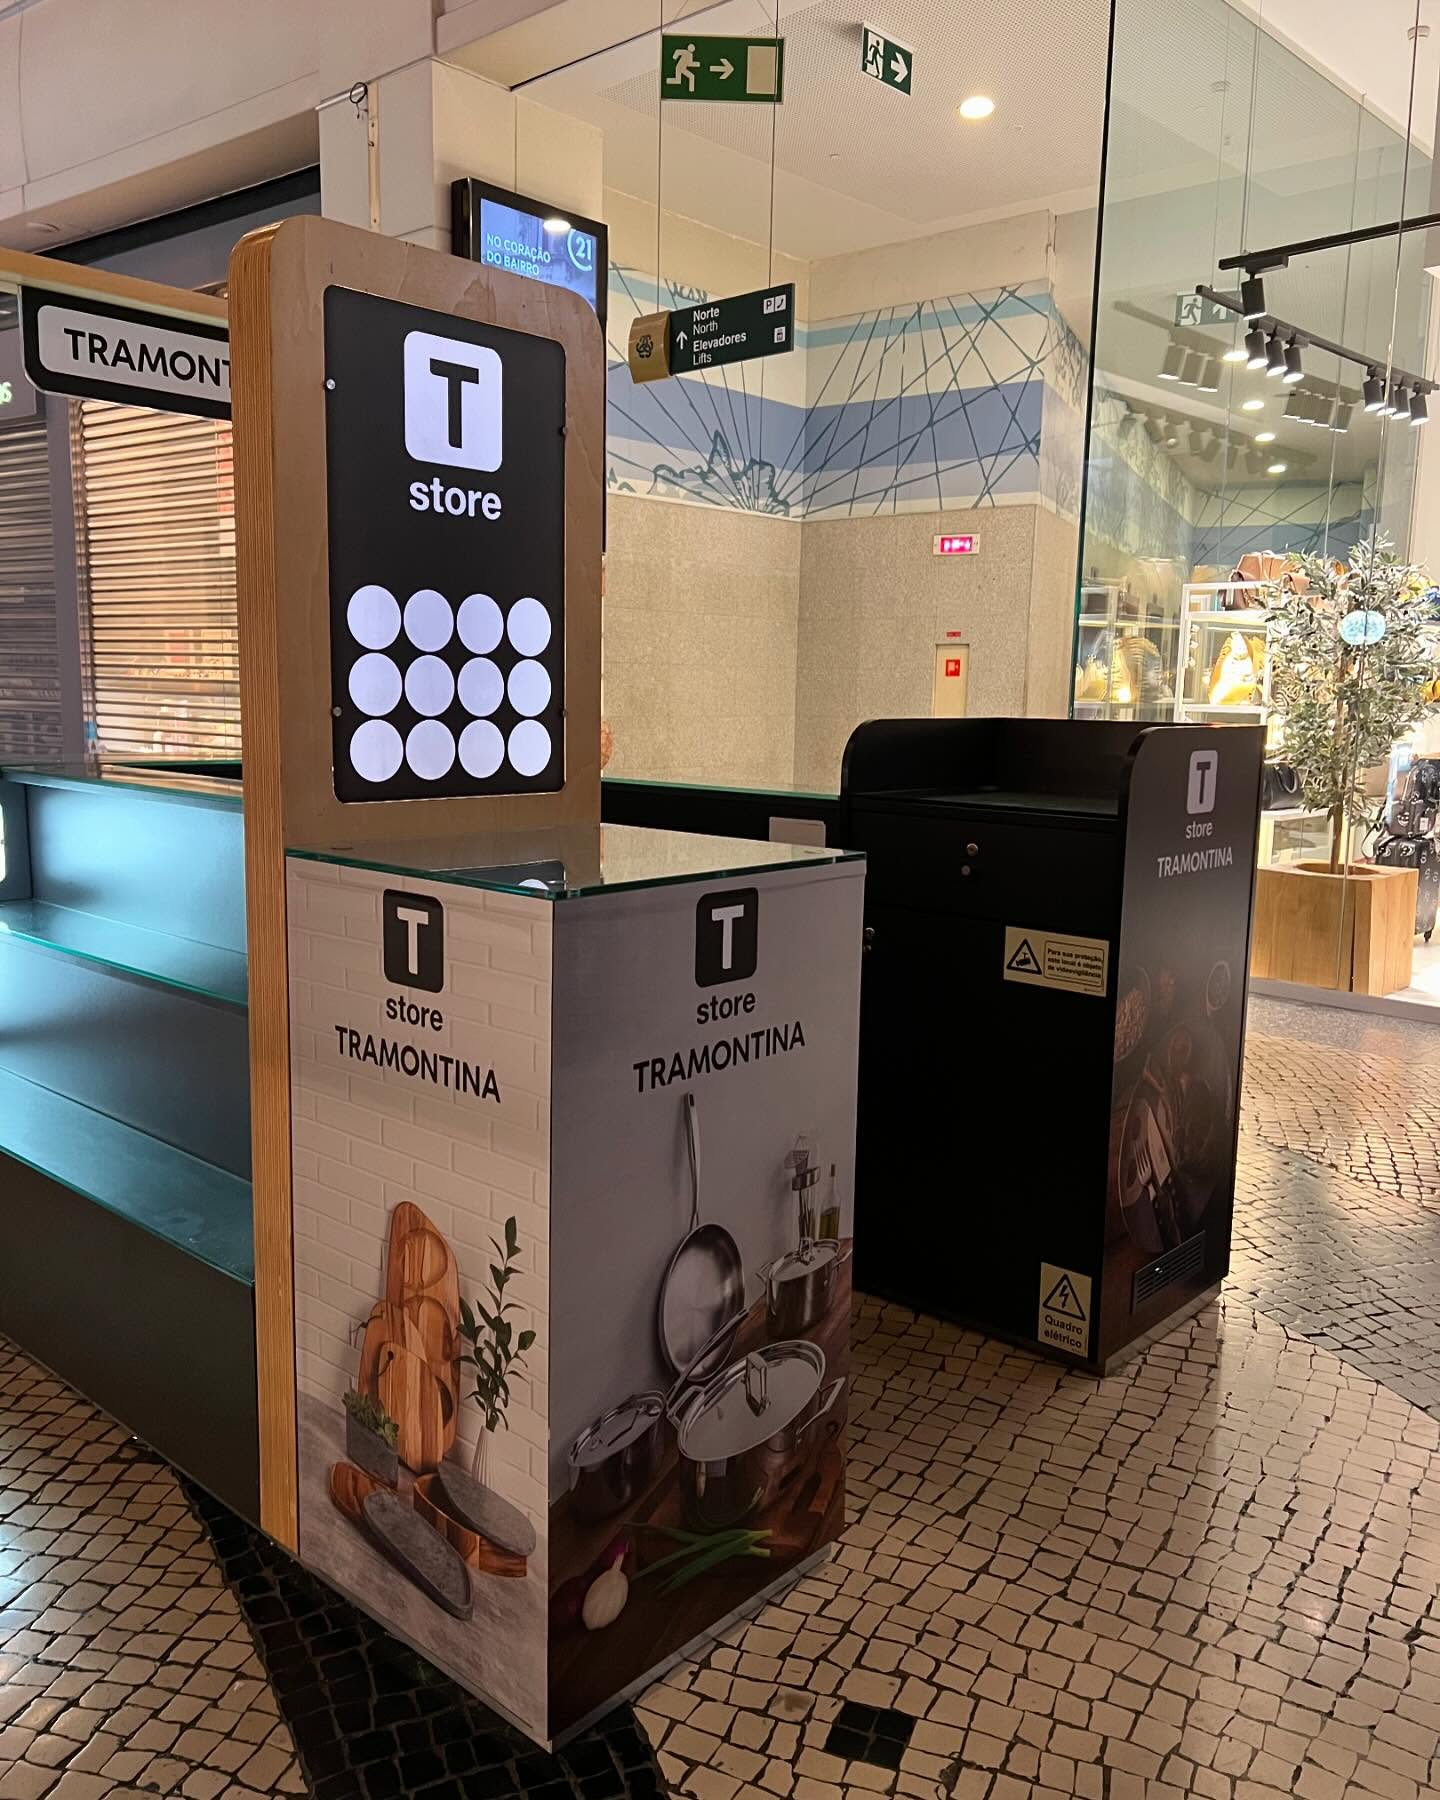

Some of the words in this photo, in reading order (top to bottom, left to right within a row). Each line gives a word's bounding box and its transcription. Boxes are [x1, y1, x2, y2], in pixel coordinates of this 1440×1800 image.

[486, 233, 501, 248] NO
[503, 239, 551, 264] CORAÇÃO
[486, 251, 501, 265] DO
[503, 256, 540, 276] BAIRRO
[693, 307, 720, 322] Norte
[693, 320, 719, 336] North
[693, 332, 747, 352] Elevadores
[693, 353, 712, 366] Lifts
[429, 358, 480, 449] T
[409, 477, 502, 521] store
[1196, 761, 1211, 805] T
[1186, 820, 1213, 839] store
[1157, 847, 1233, 878] TRAMONTINA
[397, 906, 429, 975] T
[711, 904, 745, 970] T
[386, 995, 444, 1031] store
[696, 993, 756, 1025] store
[334, 1025, 501, 1104] TRAMONTINA
[632, 1021, 806, 1093] TRAMONTINA
[1044, 1315, 1083, 1335] Quadro
[1044, 1330, 1082, 1348] elétrico
